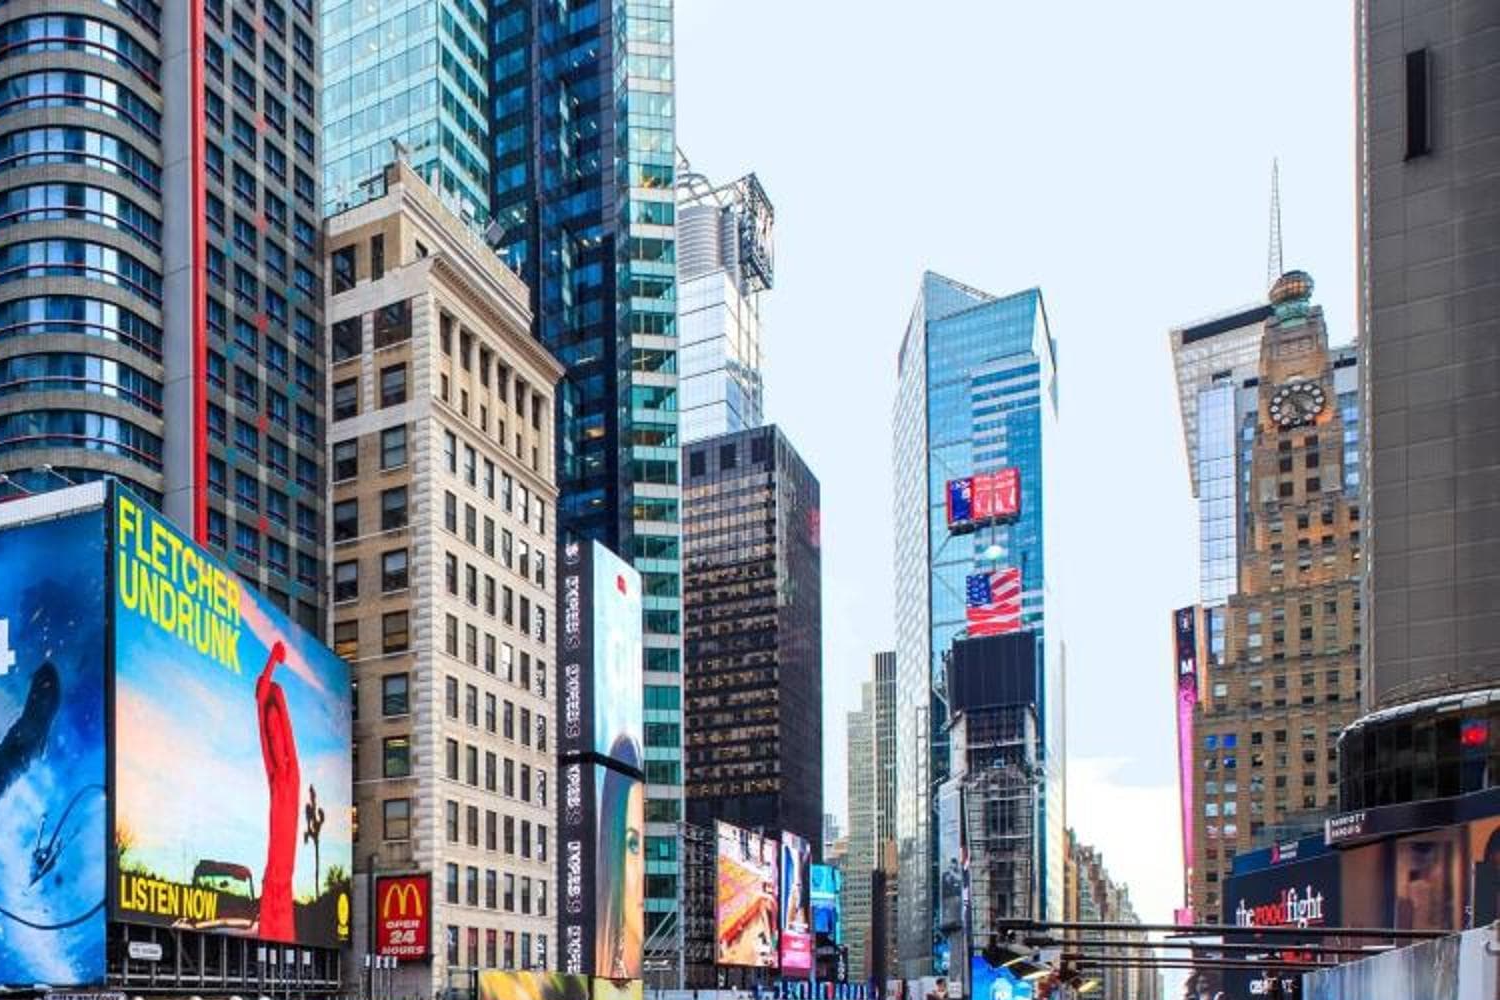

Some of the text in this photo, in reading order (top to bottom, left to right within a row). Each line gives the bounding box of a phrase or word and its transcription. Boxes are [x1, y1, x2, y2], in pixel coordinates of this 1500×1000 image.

[119, 495, 241, 628] FLETCHER
[119, 551, 241, 673] UNDRUNK
[121, 873, 217, 922] LISTEN NOW
[385, 919, 421, 929] OPEN
[389, 929, 416, 945] 24
[381, 945, 425, 956] HOURS
